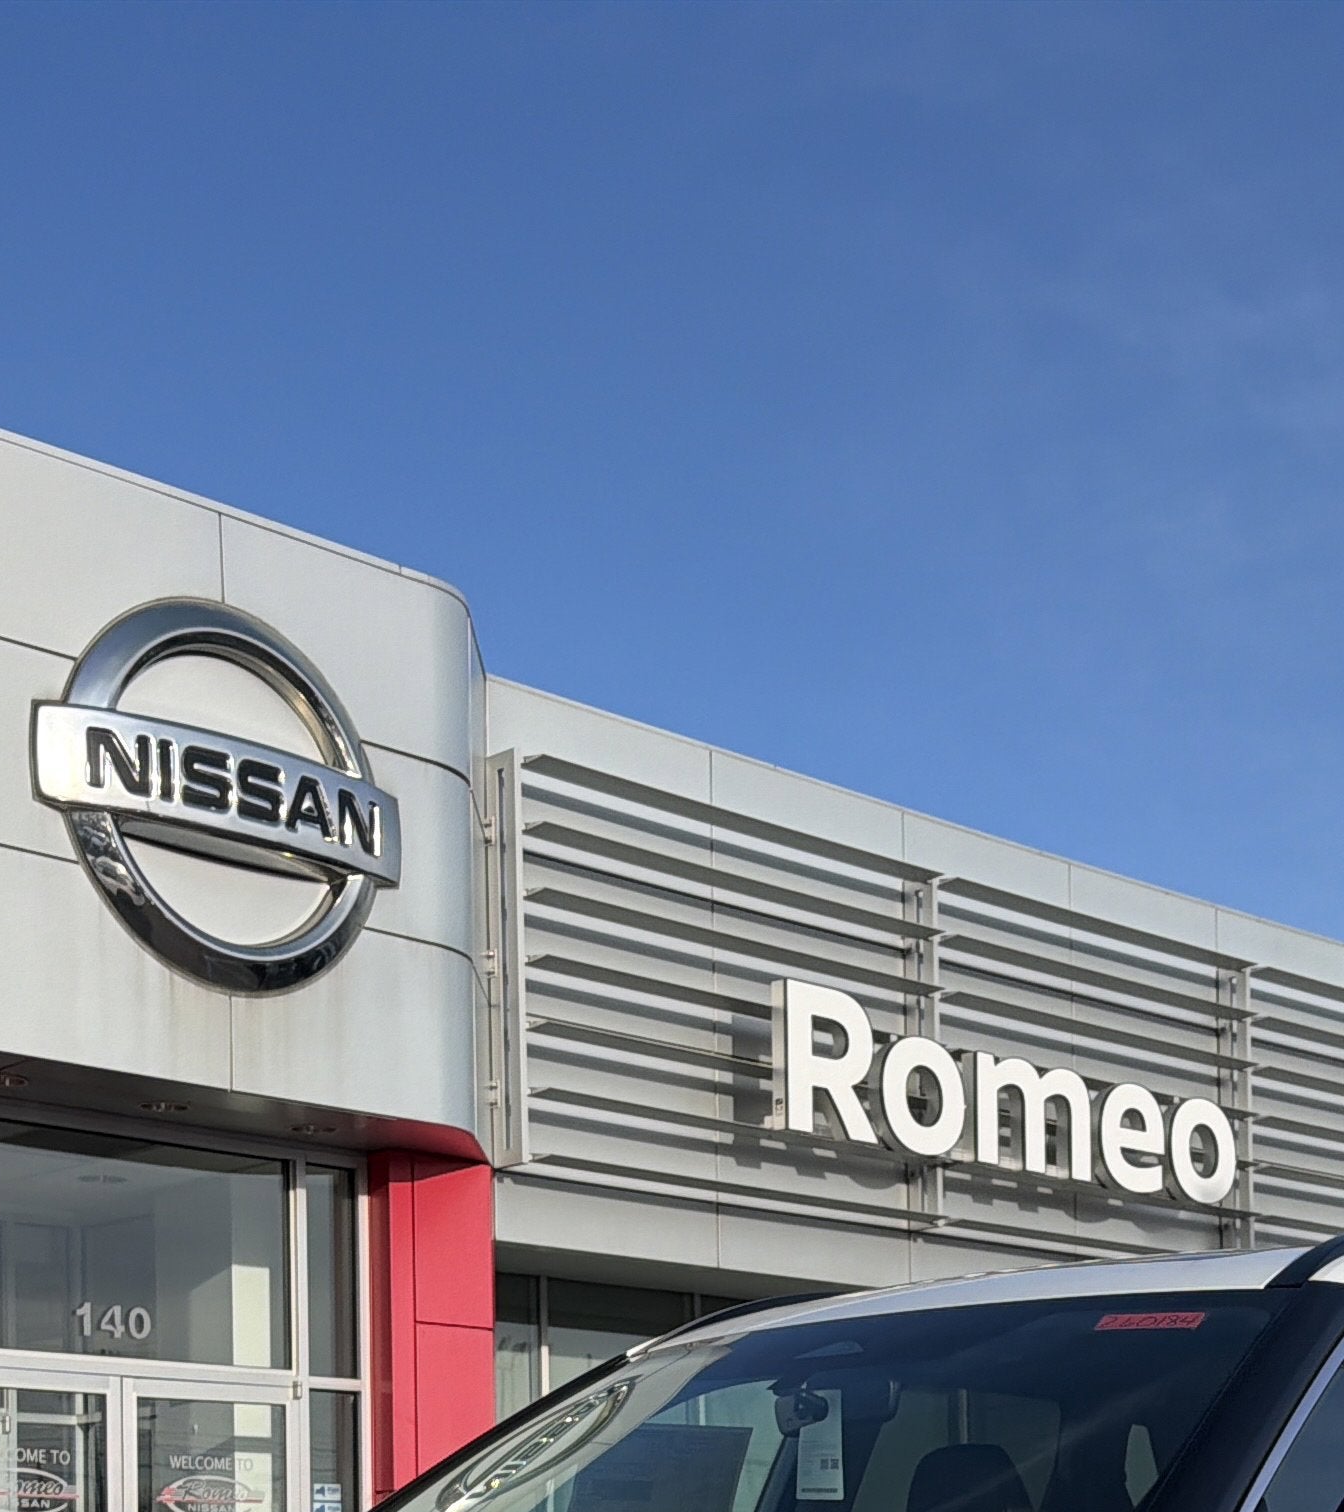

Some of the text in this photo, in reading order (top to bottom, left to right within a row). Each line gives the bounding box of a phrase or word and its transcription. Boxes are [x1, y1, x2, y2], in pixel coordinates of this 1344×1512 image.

[86, 726, 381, 857] NISSAN
[774, 977, 1237, 1205] Romeo
[75, 1301, 152, 1340] 140
[50, 1450, 71, 1466] TO
[169, 1454, 254, 1472] WELCOME TO
